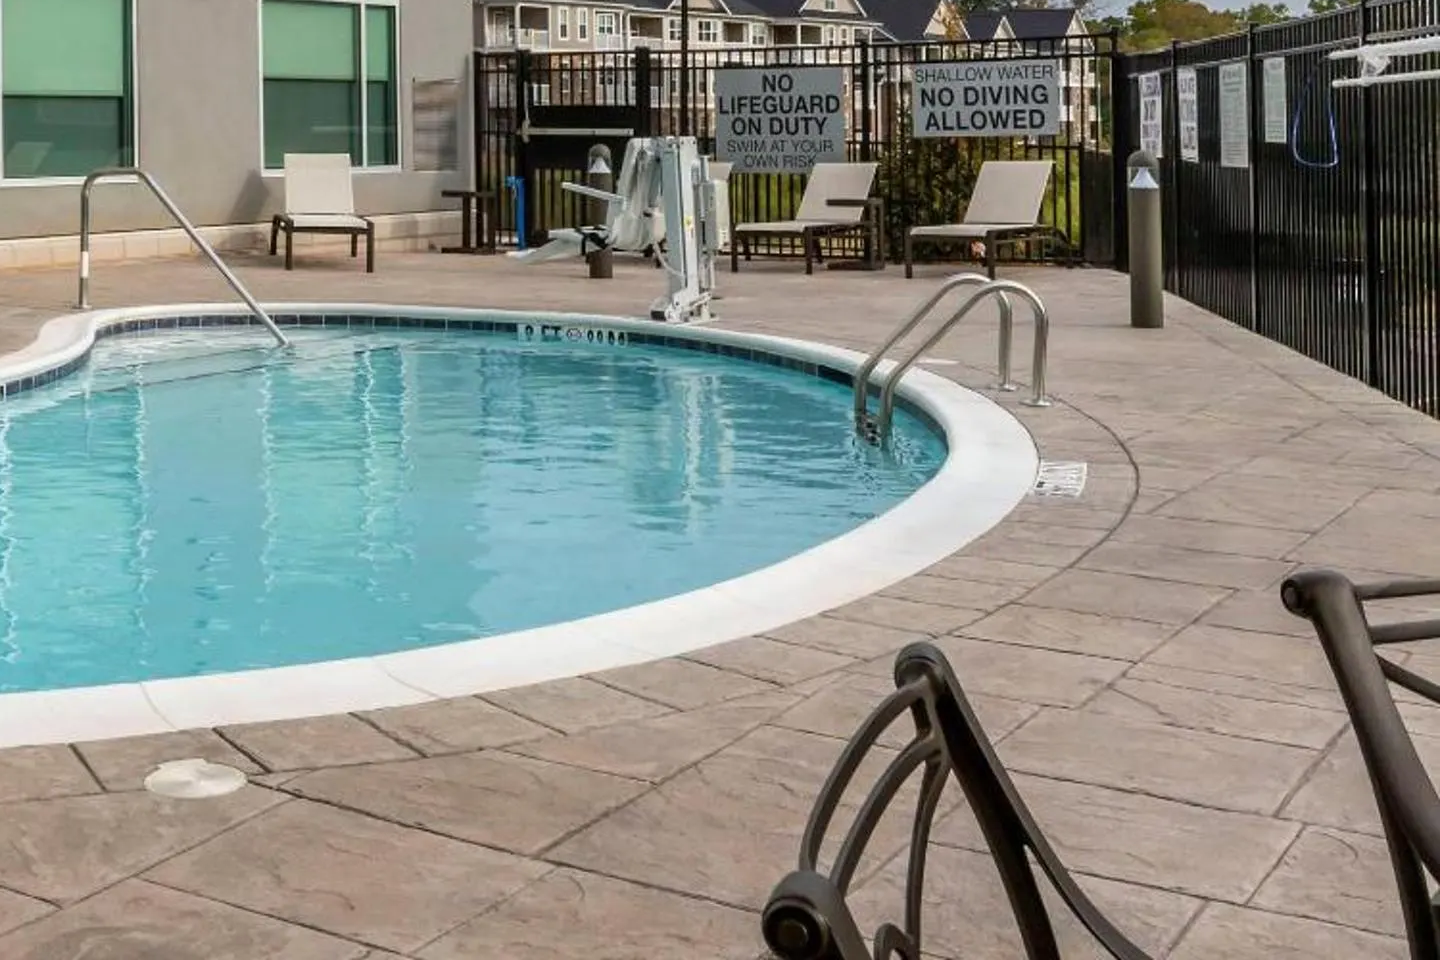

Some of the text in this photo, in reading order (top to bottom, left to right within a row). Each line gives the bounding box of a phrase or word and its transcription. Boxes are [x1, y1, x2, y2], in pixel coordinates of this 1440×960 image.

[915, 64, 1054, 83] SHALLOW WATER
[762, 74, 793, 93] NO
[719, 95, 841, 115] LIFEGUARD
[921, 84, 1050, 107] NO DIVING
[731, 116, 828, 136] ON DUTY
[925, 109, 1047, 131] ALLOWED
[727, 140, 835, 153] SWIM AT YOUR
[744, 154, 818, 168] OWN RISK
